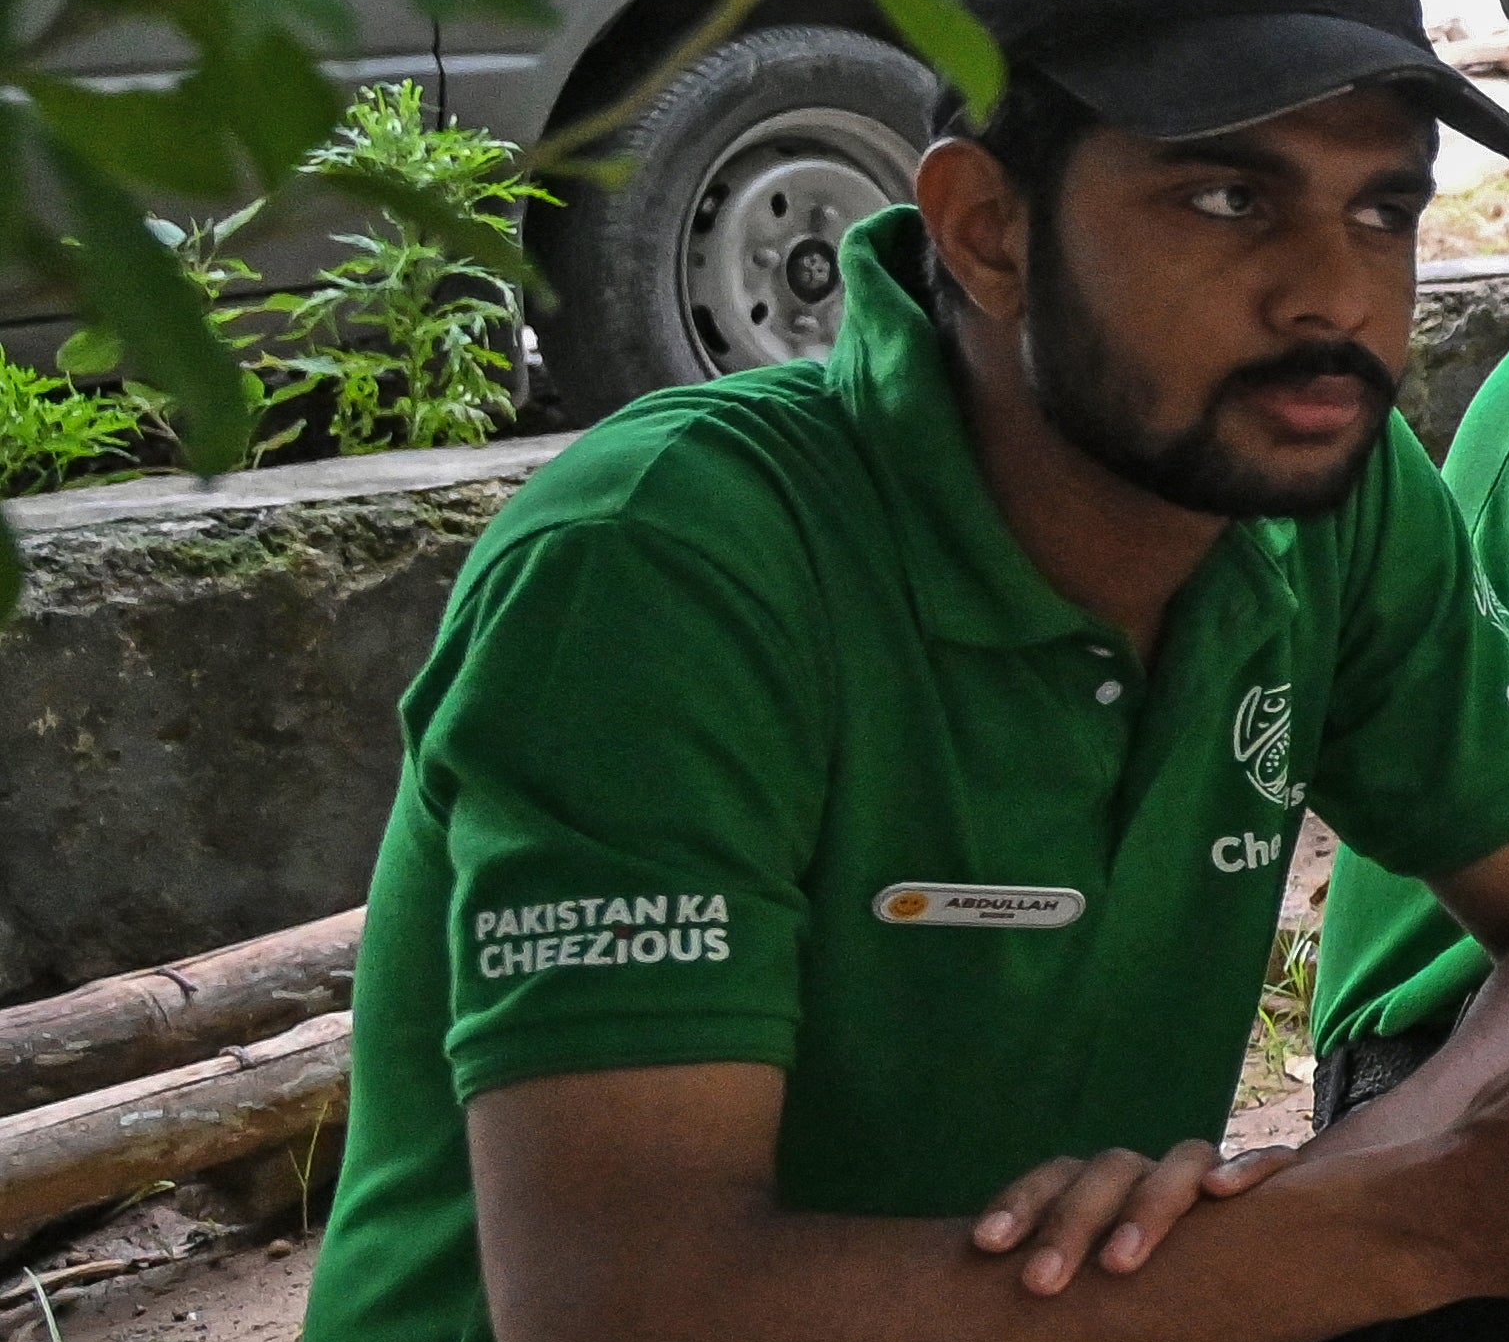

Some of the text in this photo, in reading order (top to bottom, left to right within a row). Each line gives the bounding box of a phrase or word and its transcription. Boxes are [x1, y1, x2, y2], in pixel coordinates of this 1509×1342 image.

[476, 894, 730, 940] PAKISTAN KA
[945, 897, 1060, 911] ABDULLAH
